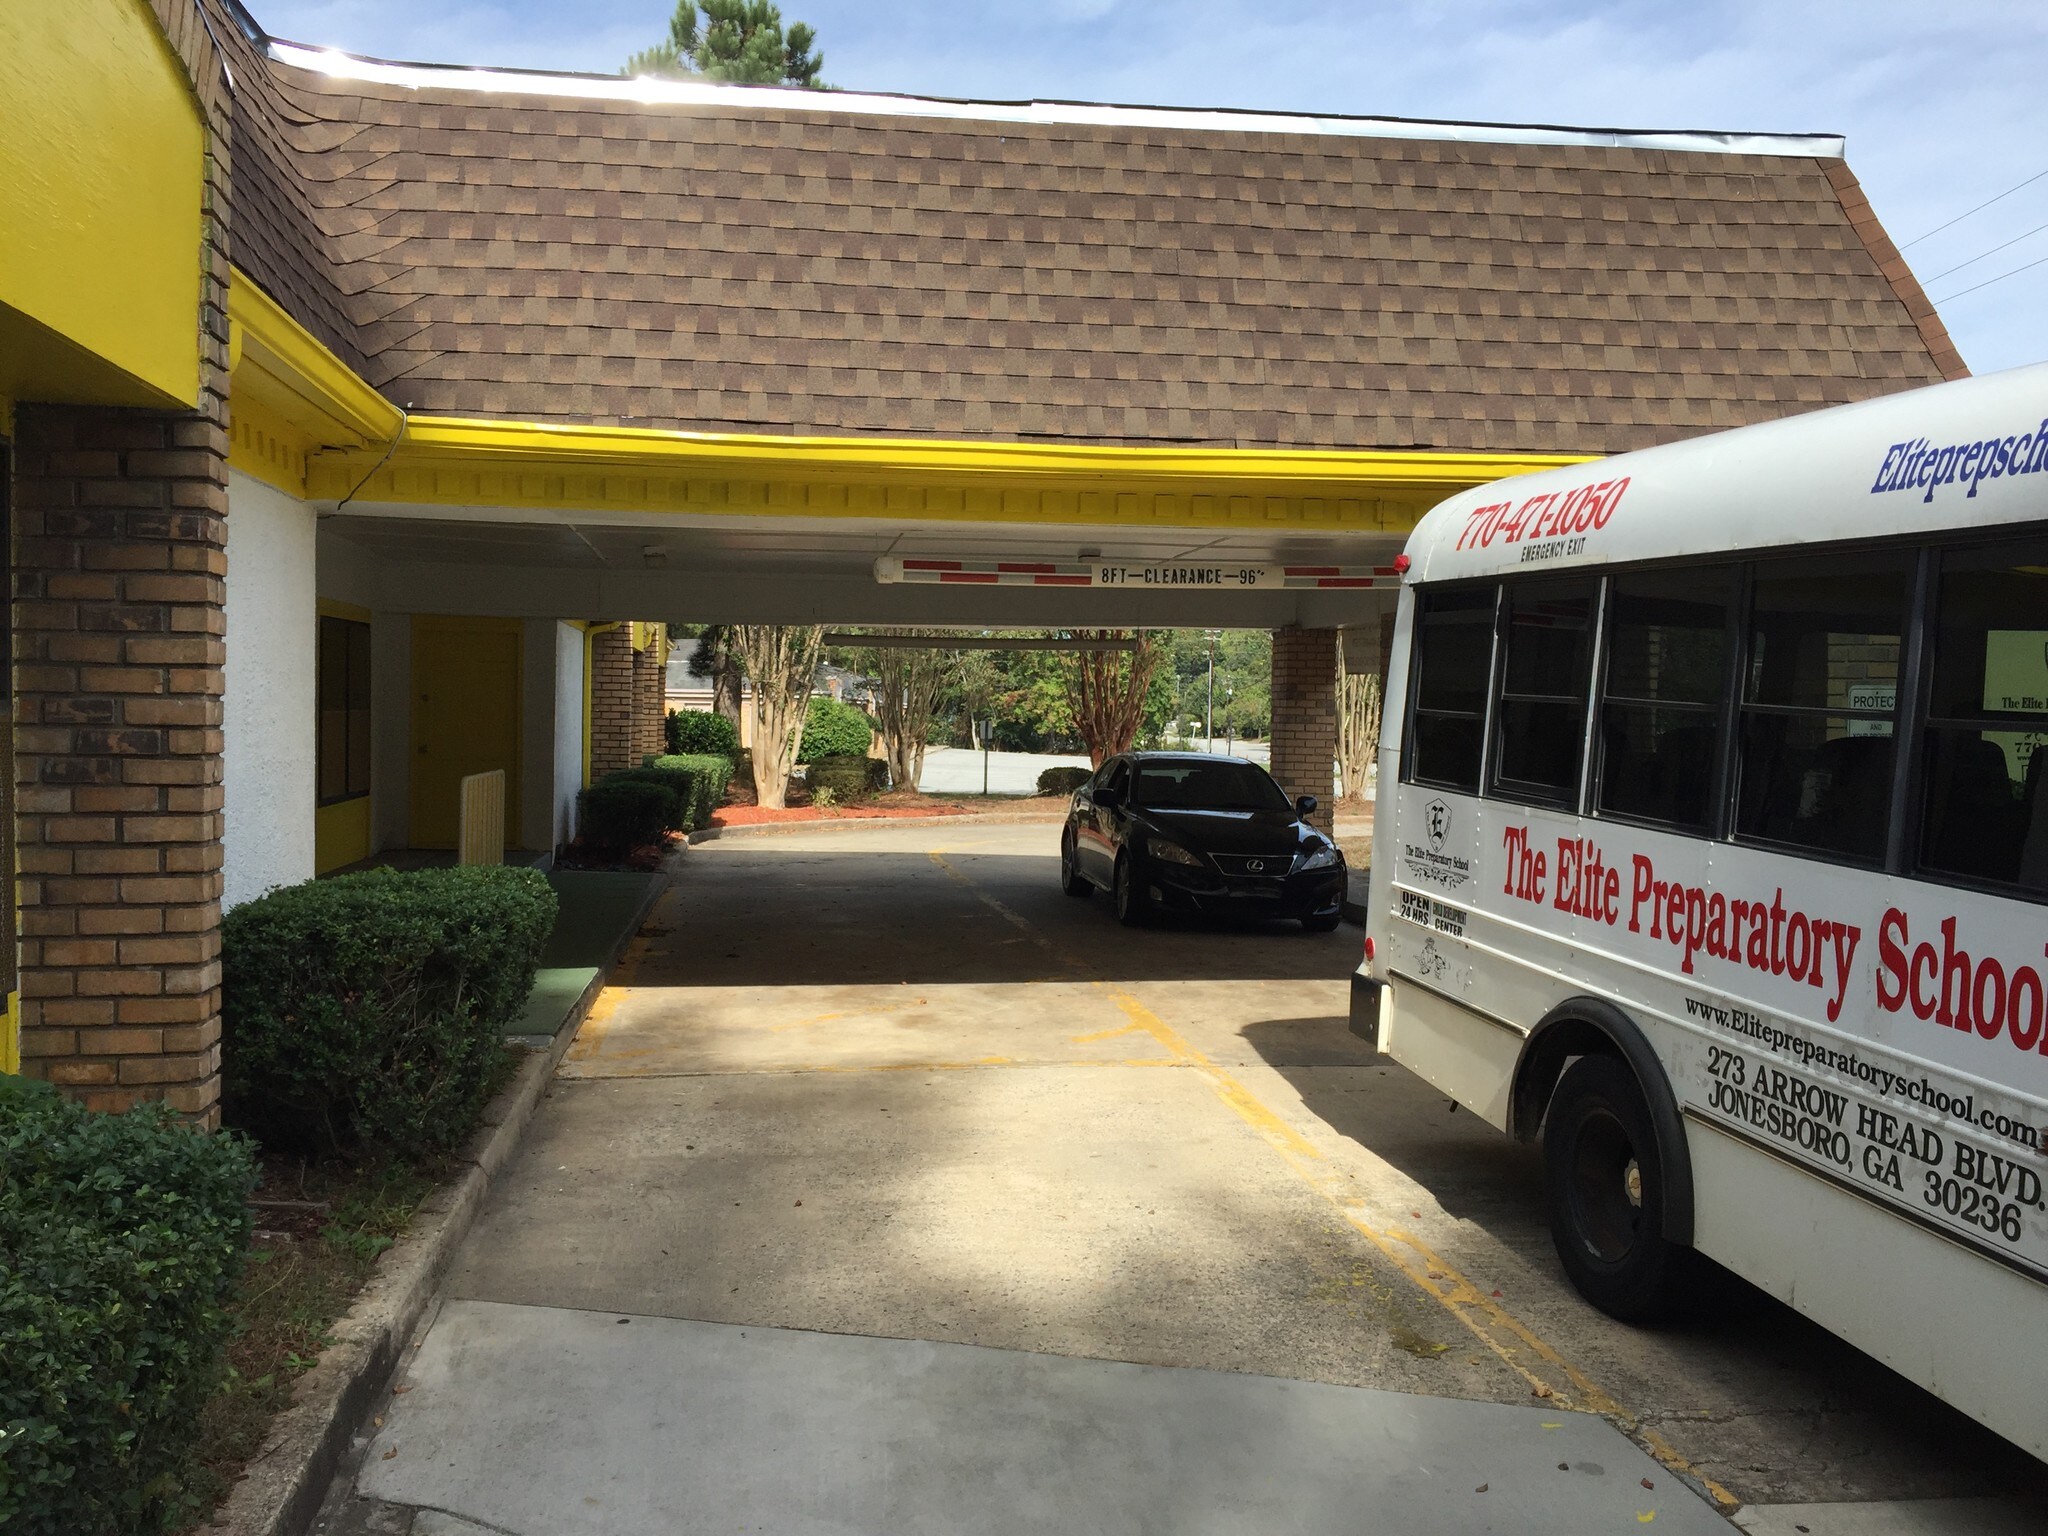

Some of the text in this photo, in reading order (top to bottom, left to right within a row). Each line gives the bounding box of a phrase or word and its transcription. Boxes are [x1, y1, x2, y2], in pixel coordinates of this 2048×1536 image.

[1871, 418, 2048, 503] Eliteprepsch
[1456, 477, 1631, 551] 770-471-1050
[1521, 537, 1586, 562] EMERGENCY EXIT
[1853, 695, 1897, 708] PROTEC
[2002, 697, 2020, 709] The
[2022, 697, 2043, 709] Elite
[1870, 723, 1883, 731] AND
[1405, 844, 1469, 871] The Elite Preparatory School
[1402, 891, 1430, 911] OPEN
[1400, 904, 1429, 925] 24 HRS
[1434, 918, 1463, 937] CENTER
[1503, 826, 1547, 904] The
[1554, 837, 1619, 926] Elite
[1628, 853, 1861, 1022] Preparatory
[1685, 998, 2039, 1149] www.Elitepreparatoryschool.com
[1707, 1045, 1746, 1086] 273
[1752, 1065, 1849, 1126] ARROW
[1856, 1102, 1943, 1166] HEAD
[1952, 1140, 2046, 1211] BLVD.
[1708, 1080, 2022, 1242] JONESBORO, GA 30236
